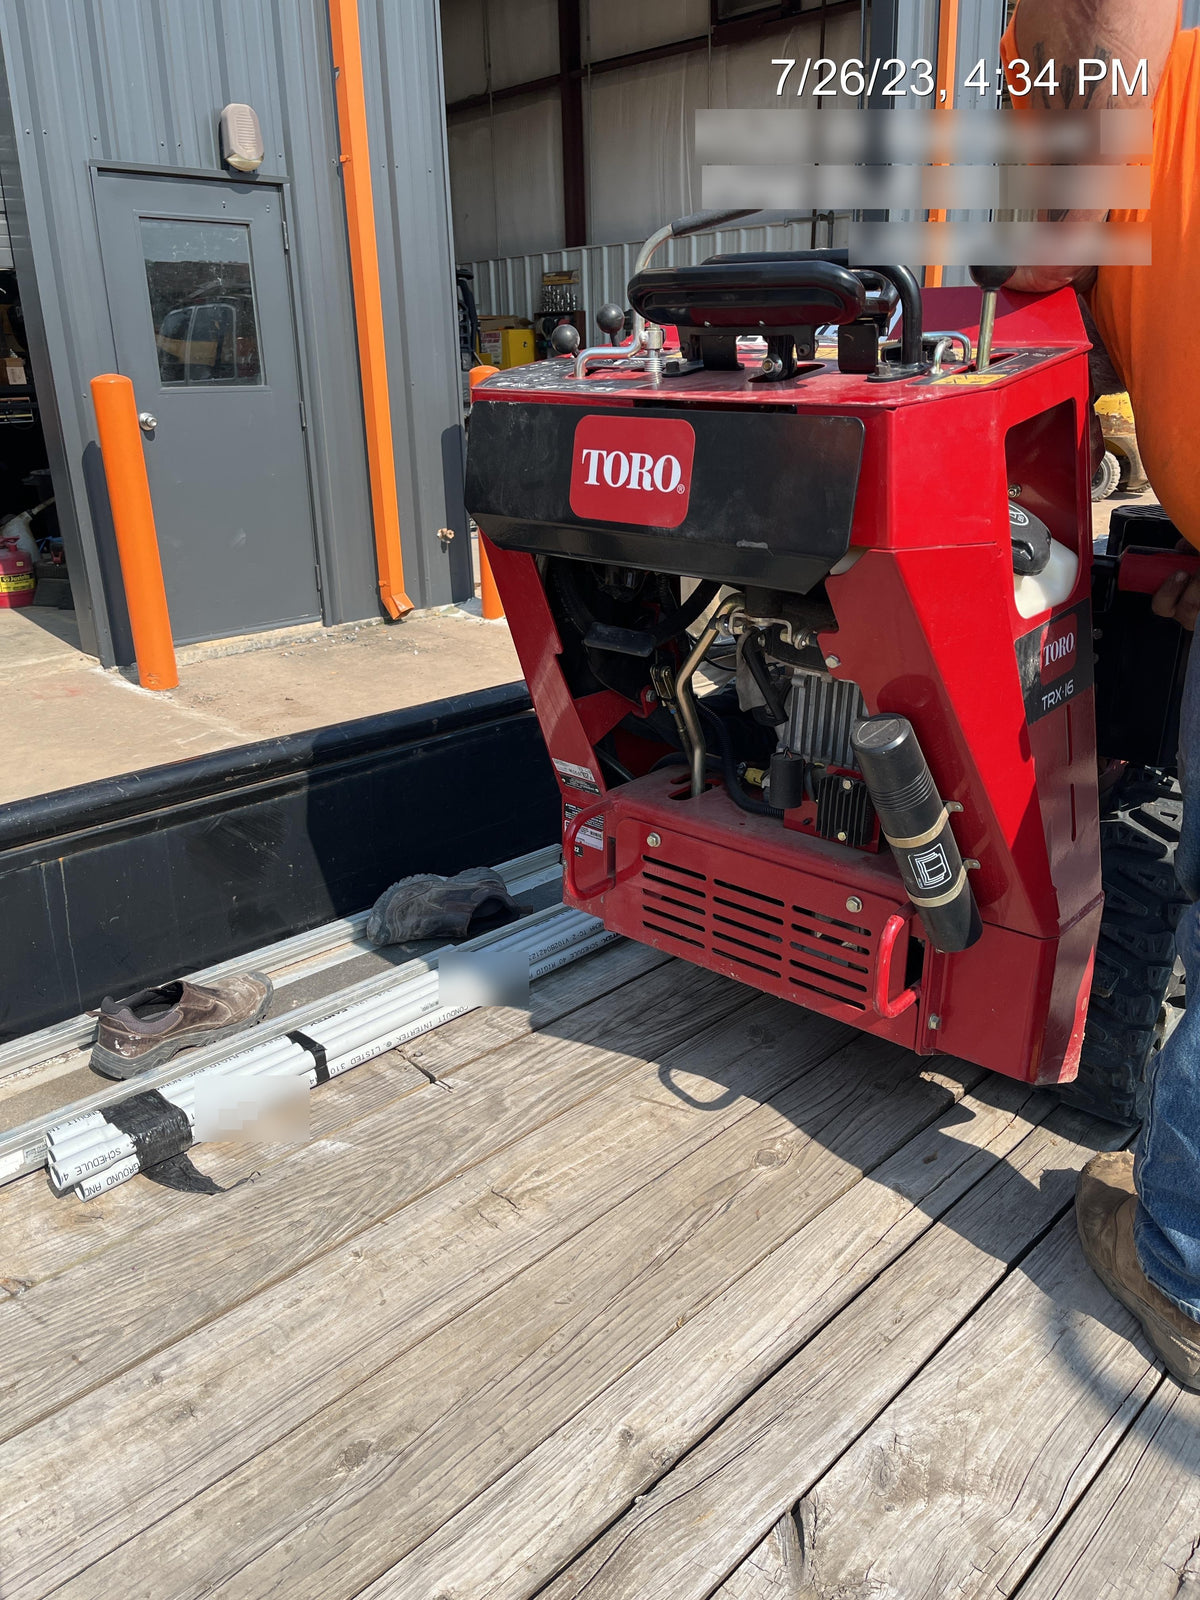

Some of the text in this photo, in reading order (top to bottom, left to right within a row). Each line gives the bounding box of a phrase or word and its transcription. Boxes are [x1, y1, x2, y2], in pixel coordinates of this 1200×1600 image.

[1043, 632, 1074, 666] TORO
[350, 1046, 381, 1065] LISTED
[74, 1147, 122, 1176] SCHEDULE
